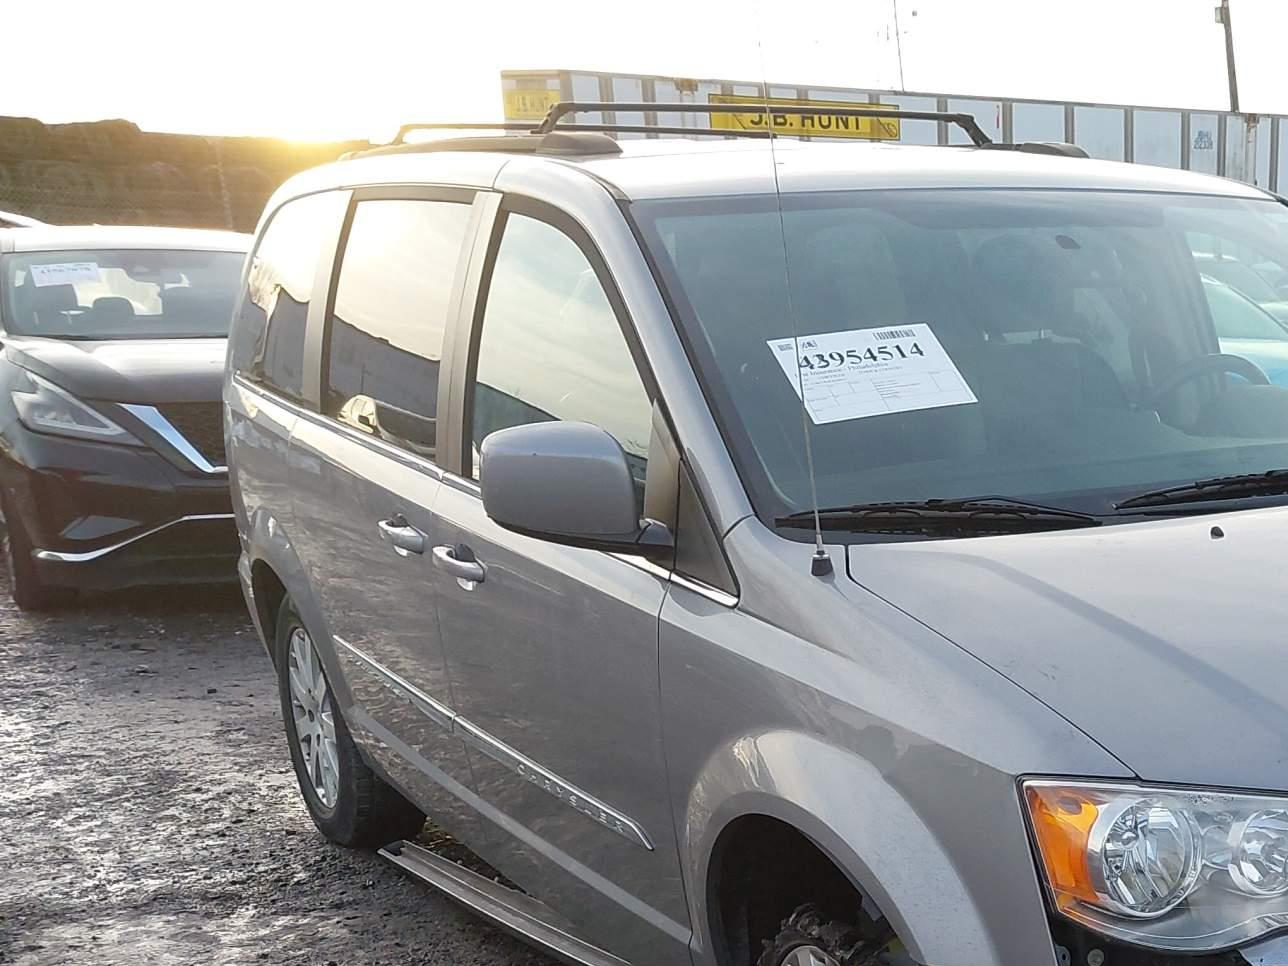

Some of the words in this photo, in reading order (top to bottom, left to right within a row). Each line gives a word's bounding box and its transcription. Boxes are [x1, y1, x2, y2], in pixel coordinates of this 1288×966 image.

[750, 112, 793, 127] J.B.
[801, 112, 860, 130] HUNT
[800, 342, 925, 370] 43954514
[517, 764, 624, 833] CHRYSLER
